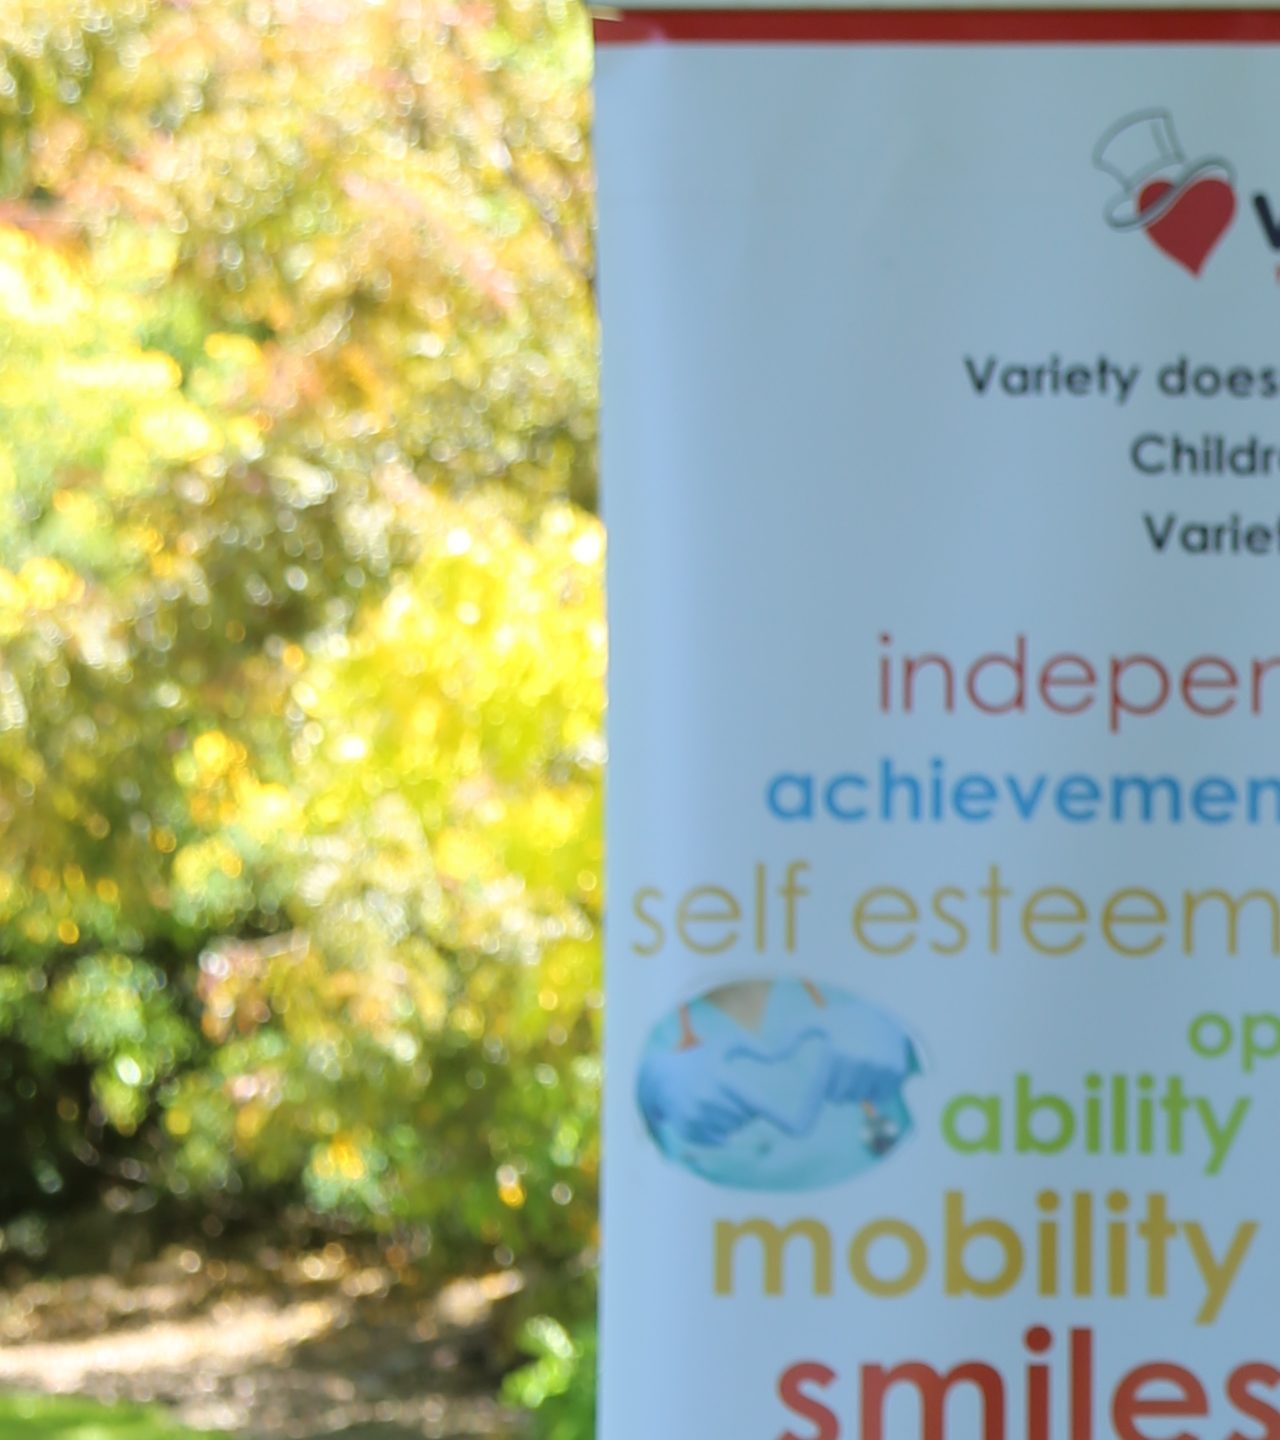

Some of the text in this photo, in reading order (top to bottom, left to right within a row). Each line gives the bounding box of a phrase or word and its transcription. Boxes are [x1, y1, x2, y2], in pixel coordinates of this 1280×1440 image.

[964, 356, 1139, 404] Variety
[631, 860, 809, 957] self
[941, 1074, 1252, 1174] ability
[714, 1190, 1258, 1324] mobility
